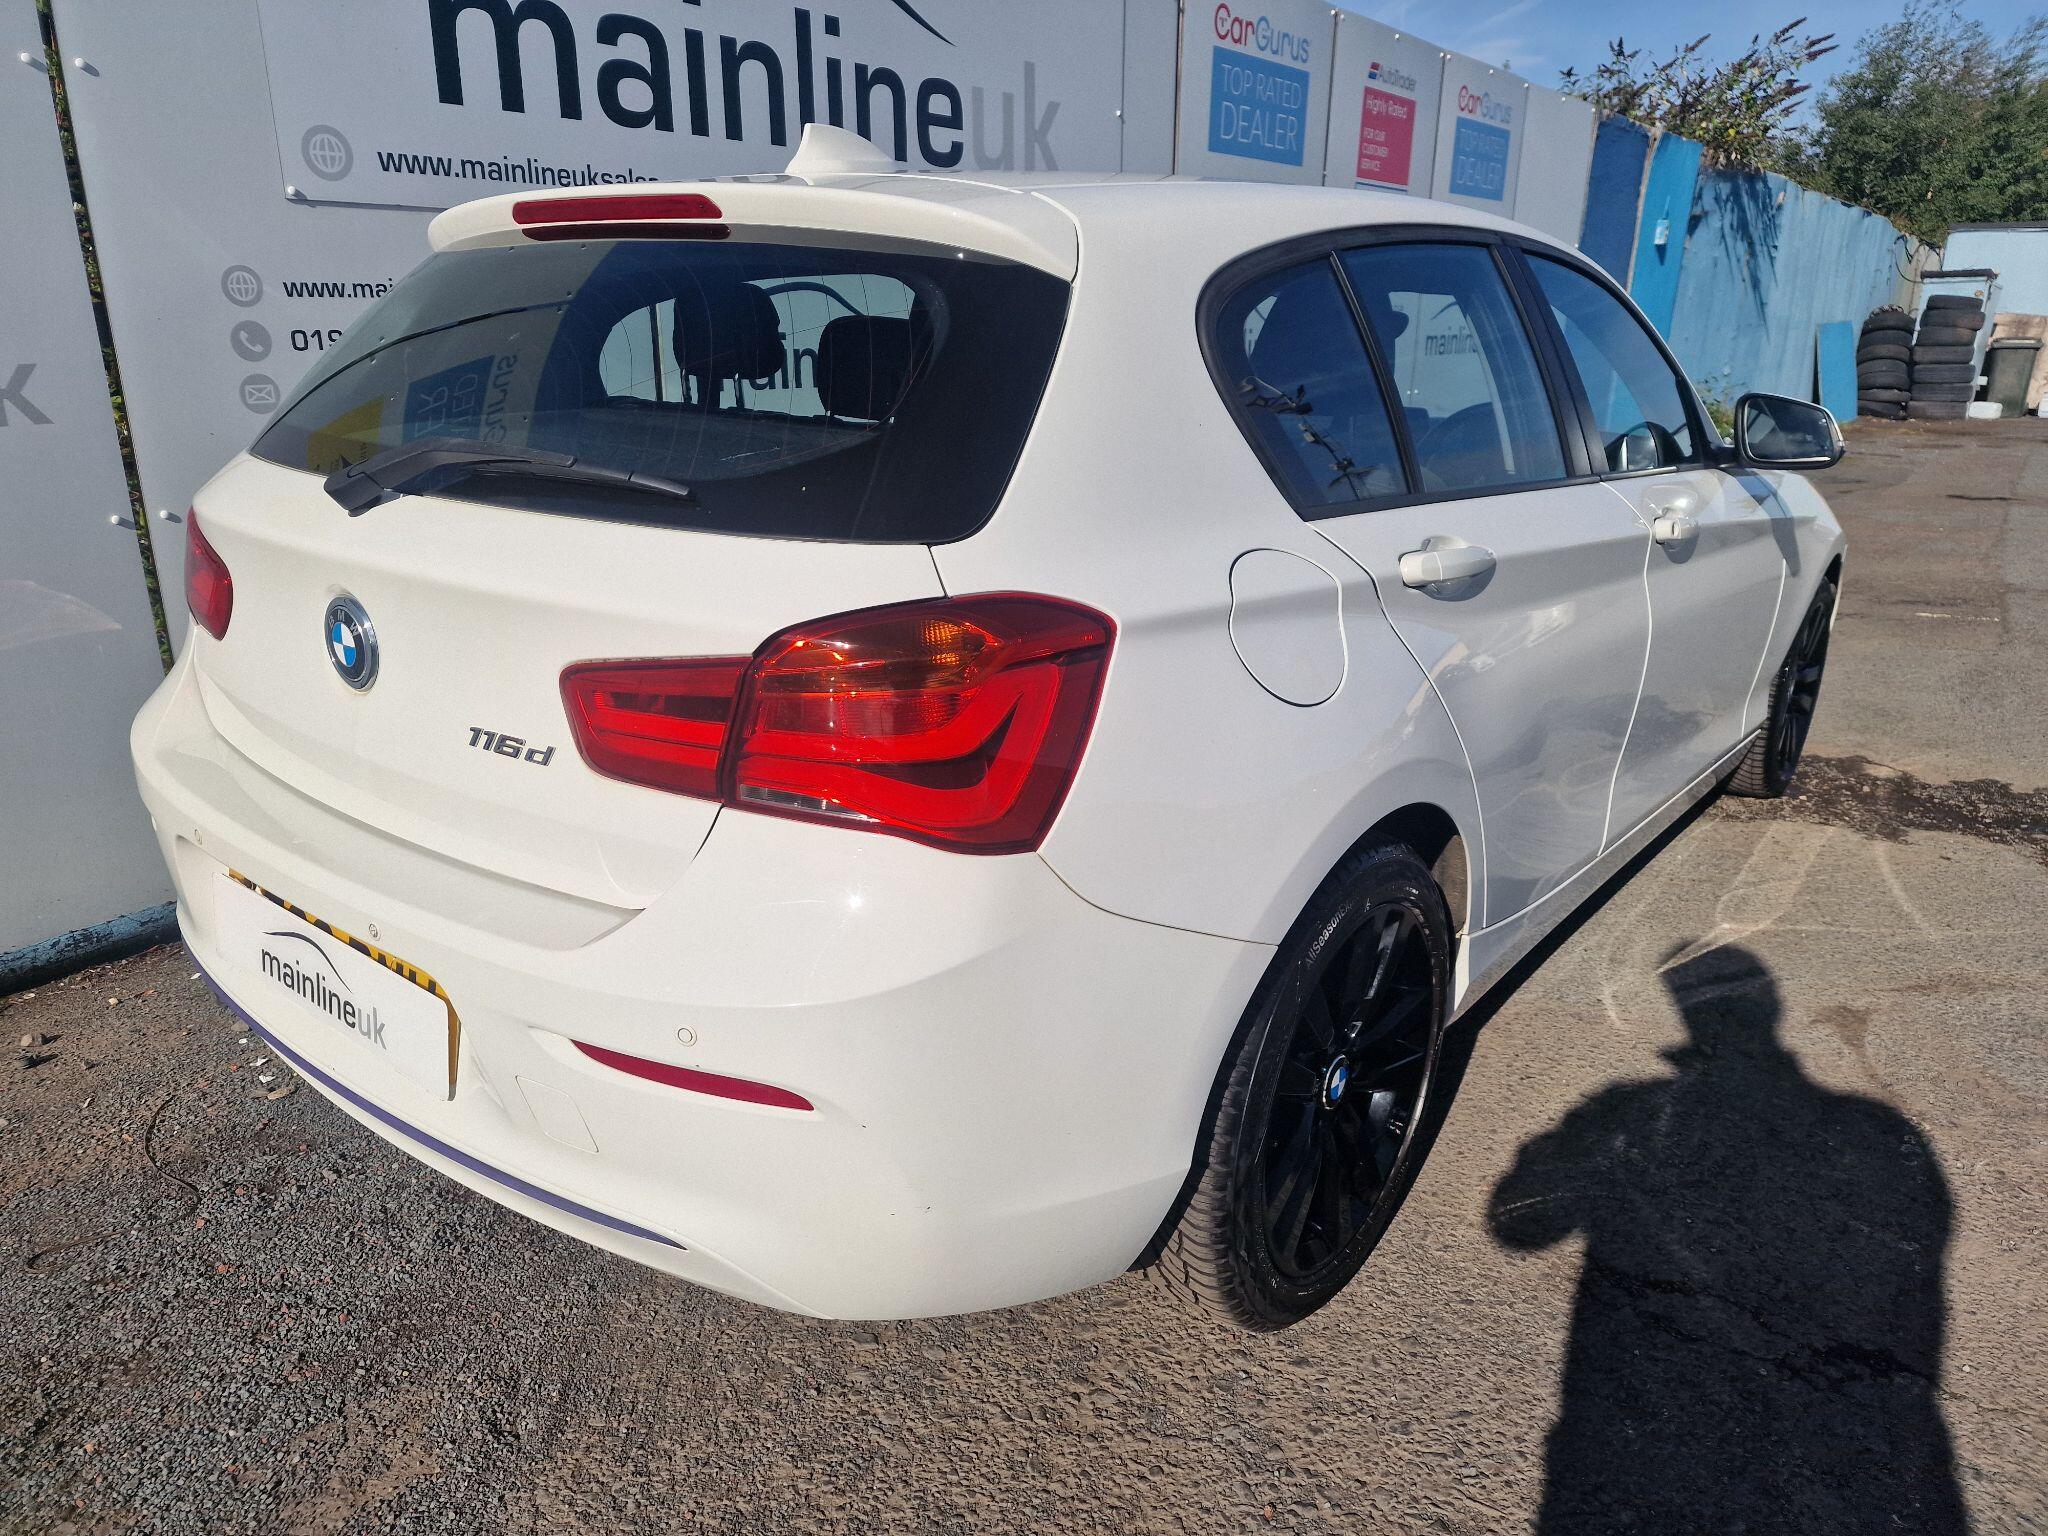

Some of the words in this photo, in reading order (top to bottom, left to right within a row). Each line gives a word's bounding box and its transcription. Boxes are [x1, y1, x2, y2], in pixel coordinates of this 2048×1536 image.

[1214, 3, 1310, 64] CarGurus
[1221, 64, 1253, 96] TOP
[1256, 73, 1302, 109] RATED
[1220, 101, 1298, 151] DEALER
[468, 726, 556, 767] 116d
[261, 948, 387, 1050] mainlineuk
